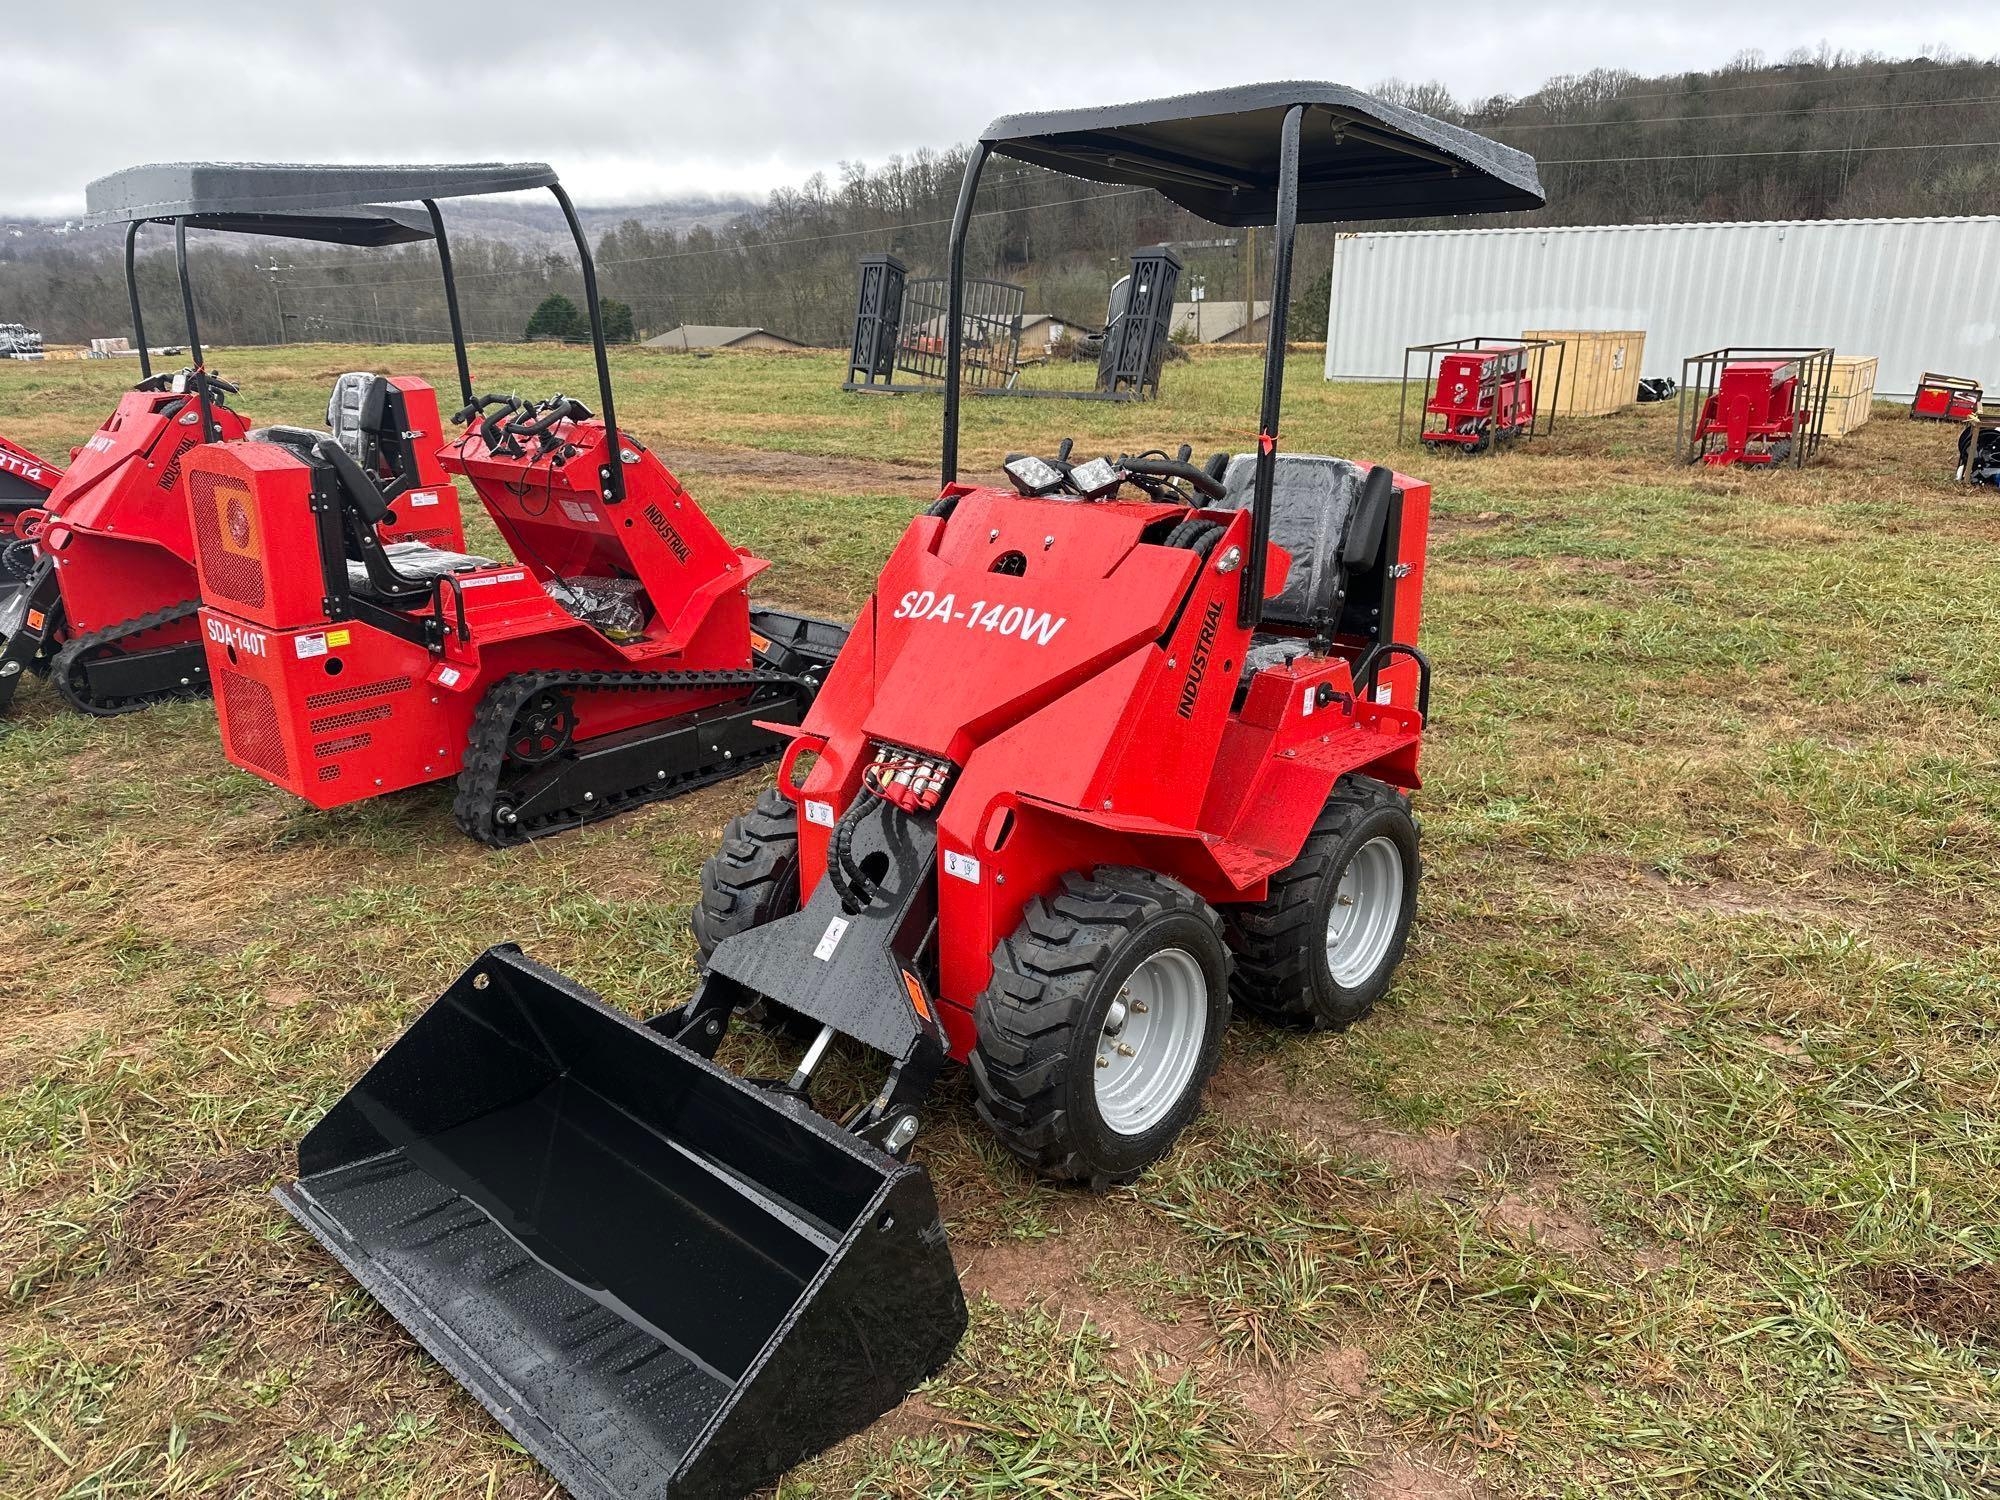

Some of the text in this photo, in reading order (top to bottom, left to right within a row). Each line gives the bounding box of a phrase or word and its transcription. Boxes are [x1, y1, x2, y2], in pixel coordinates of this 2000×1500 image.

[644, 503, 691, 564] INDUSTRIAL
[207, 618, 266, 658] SDA-140T
[893, 591, 1067, 646] SDA-140W
[1178, 601, 1223, 720] INDUSTRIAL
